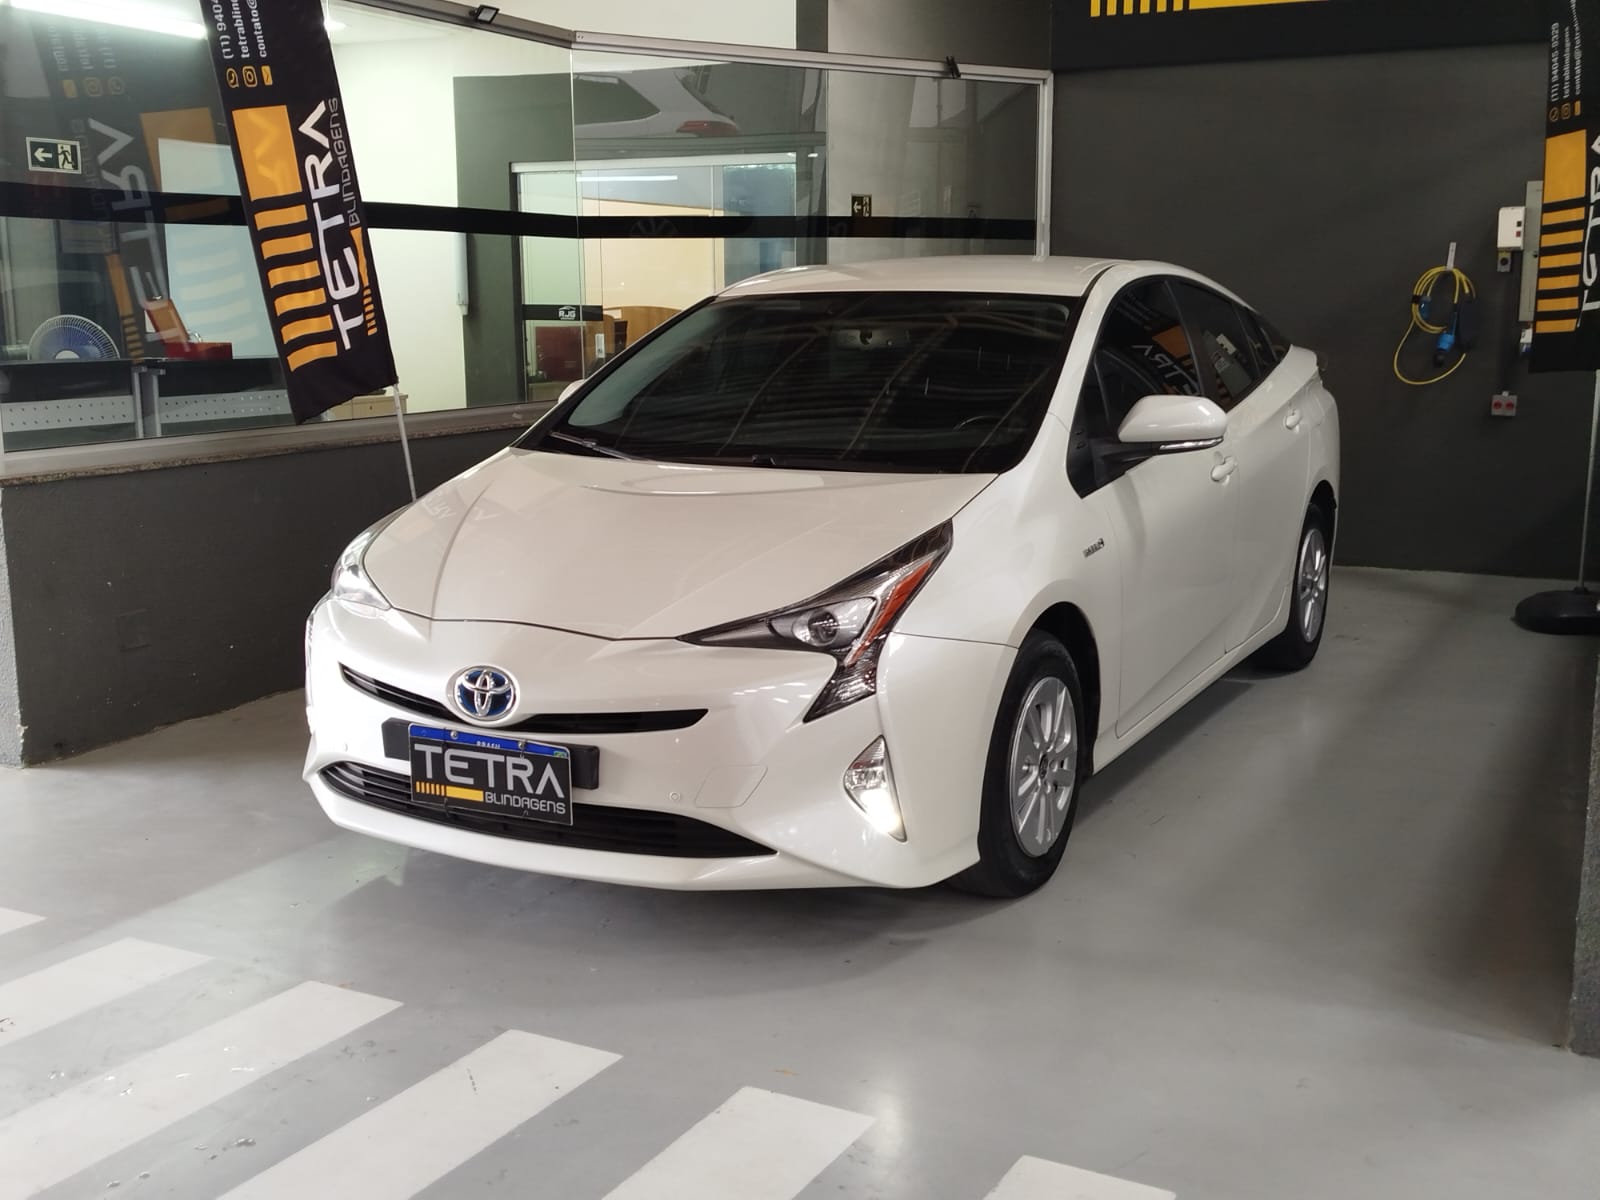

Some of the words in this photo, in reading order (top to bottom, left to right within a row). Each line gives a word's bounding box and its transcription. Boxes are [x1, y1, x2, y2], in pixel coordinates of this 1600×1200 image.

[219, 35, 235, 59] (11)
[1551, 83, 1559, 102] (11)
[328, 97, 361, 226] BLINDAGENS
[299, 100, 364, 350] TETRA
[414, 743, 565, 798] TETRA
[485, 791, 567, 816] BLINDAGENS
